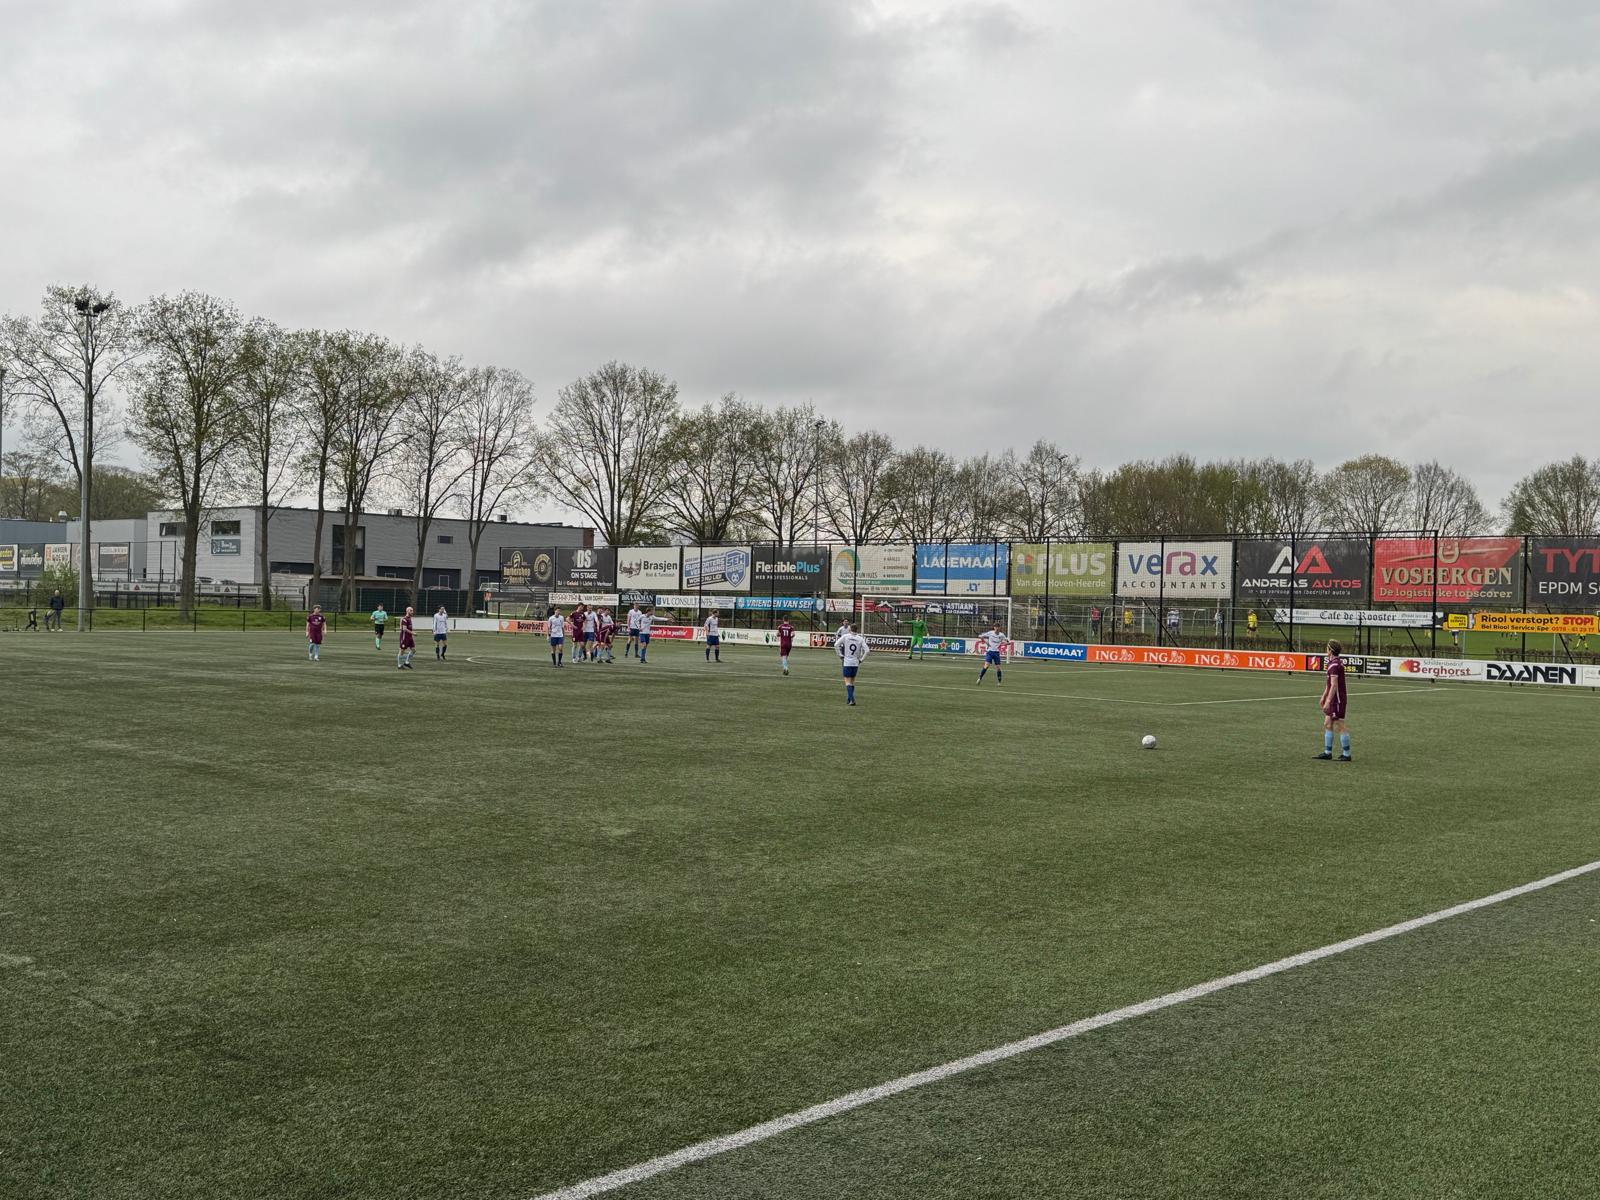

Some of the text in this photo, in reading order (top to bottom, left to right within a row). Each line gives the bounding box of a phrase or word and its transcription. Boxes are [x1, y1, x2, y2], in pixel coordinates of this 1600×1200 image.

[576, 550, 592, 568] DS
[1037, 553, 1106, 575] PLUS
[1128, 551, 1218, 576] verax
[643, 561, 678, 572] Brasjen
[756, 562, 820, 573] FlexiblePlus
[1381, 567, 1513, 584] VOSBERGEN
[1017, 579, 1030, 587] Van
[1242, 579, 1361, 588] ANDREAS AUTOS
[1539, 582, 1582, 594] EPDM
[1380, 587, 1512, 598] De logistike topscorer
[663, 597, 670, 605] VL
[671, 597, 713, 606] CONSULTNTS
[747, 600, 782, 608] VRIENDEN
[783, 600, 798, 608] VAN
[1344, 612, 1353, 620] de
[1358, 612, 1397, 622] Rooster
[1510, 616, 1560, 626] verstopt?
[1562, 617, 1593, 626] STOP!
[864, 637, 909, 646] ERGHORST
[850, 644, 857, 656] 9
[1028, 646, 1083, 657] LAGEMAAT
[1096, 650, 1118, 660] ING
[1144, 652, 1168, 662] ING
[1195, 654, 1220, 665] ING
[1248, 656, 1276, 668] ING
[1348, 658, 1362, 666] Rib
[1409, 660, 1472, 676] Berghorst
[1486, 664, 1576, 684] DAANEN
